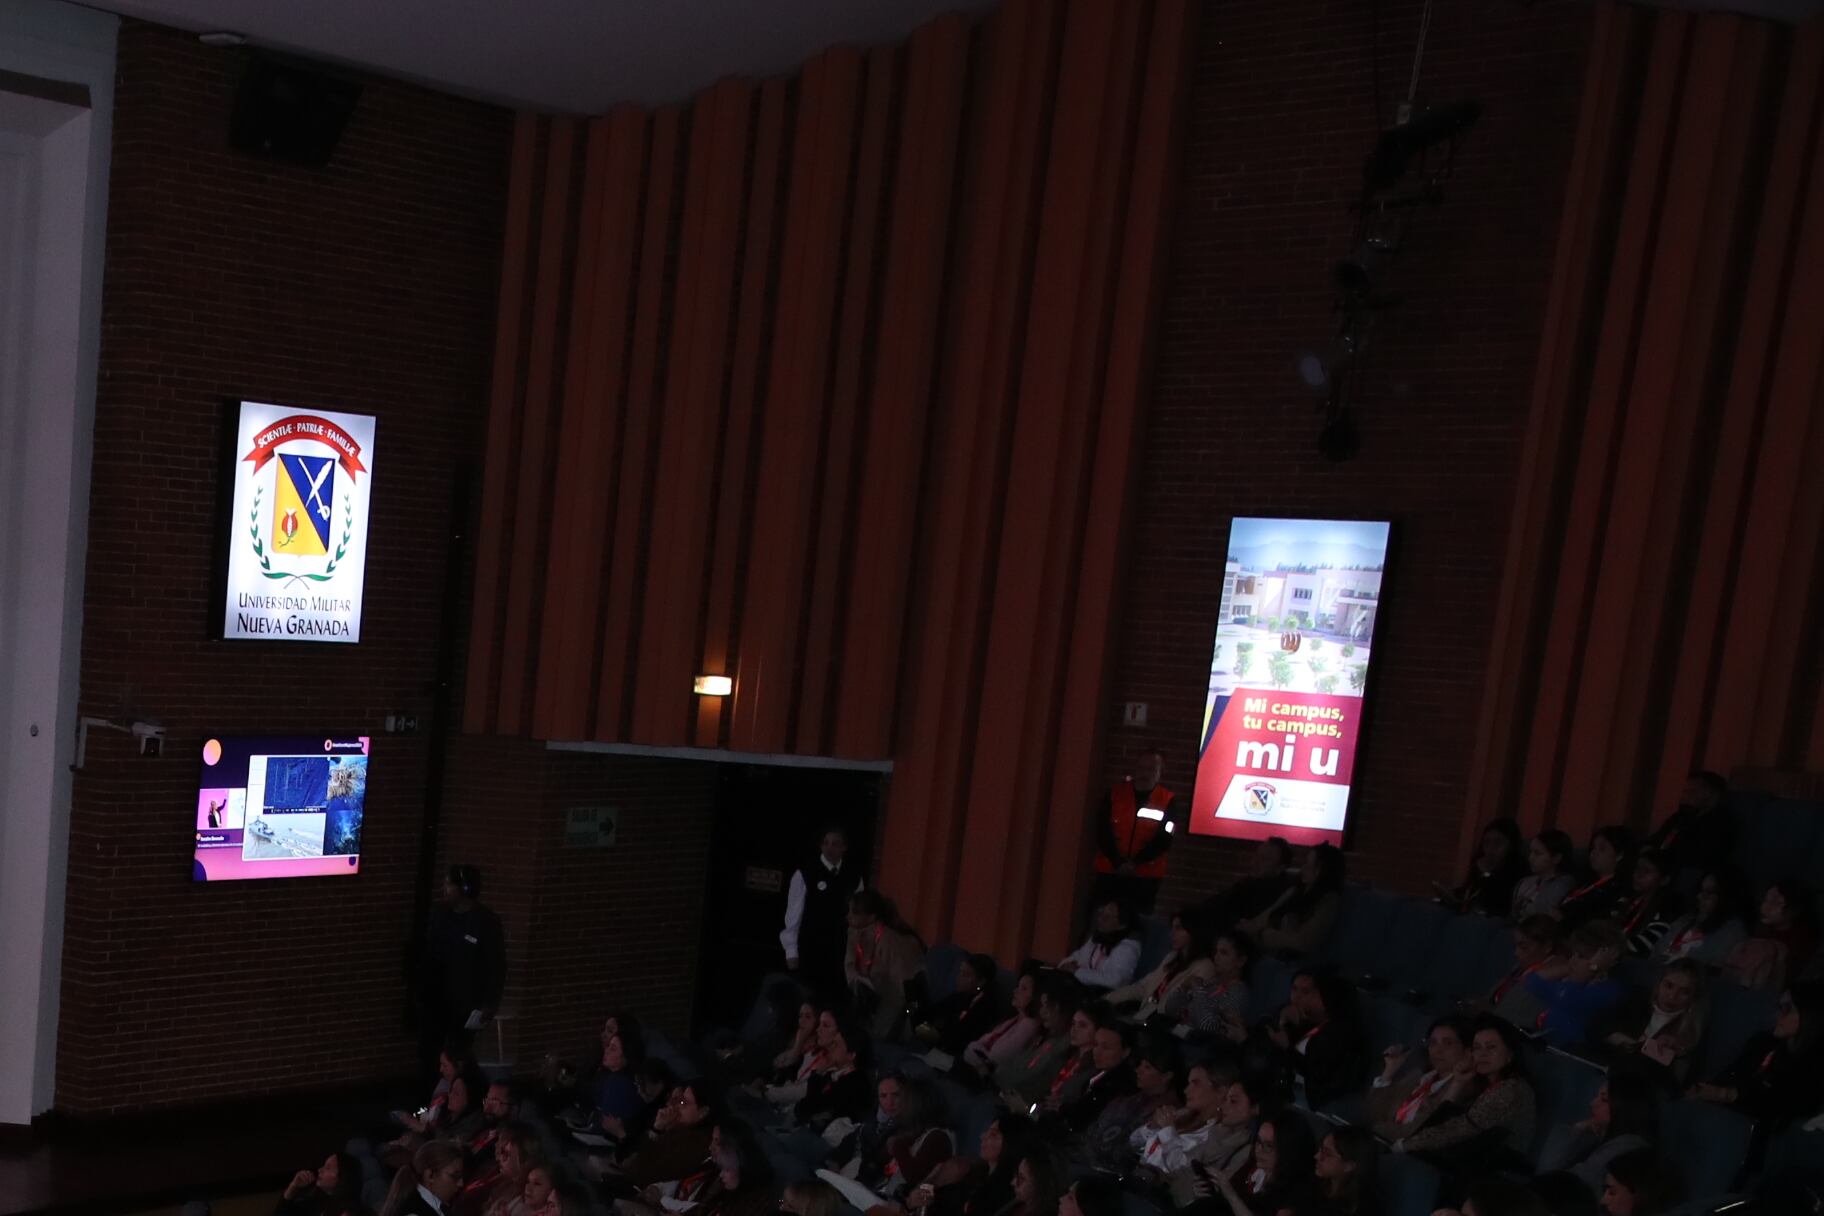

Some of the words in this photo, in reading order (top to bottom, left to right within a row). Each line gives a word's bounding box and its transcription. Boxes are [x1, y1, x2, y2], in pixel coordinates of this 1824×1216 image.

[237, 613, 282, 634] NUEVA
[286, 614, 349, 635] GRANADA
[1244, 698, 1267, 713] Mi
[1271, 703, 1344, 722] campus,
[1243, 715, 1262, 729] tu
[1267, 719, 1342, 738] campus,
[1236, 734, 1296, 772] mi
[1309, 747, 1339, 776] u
